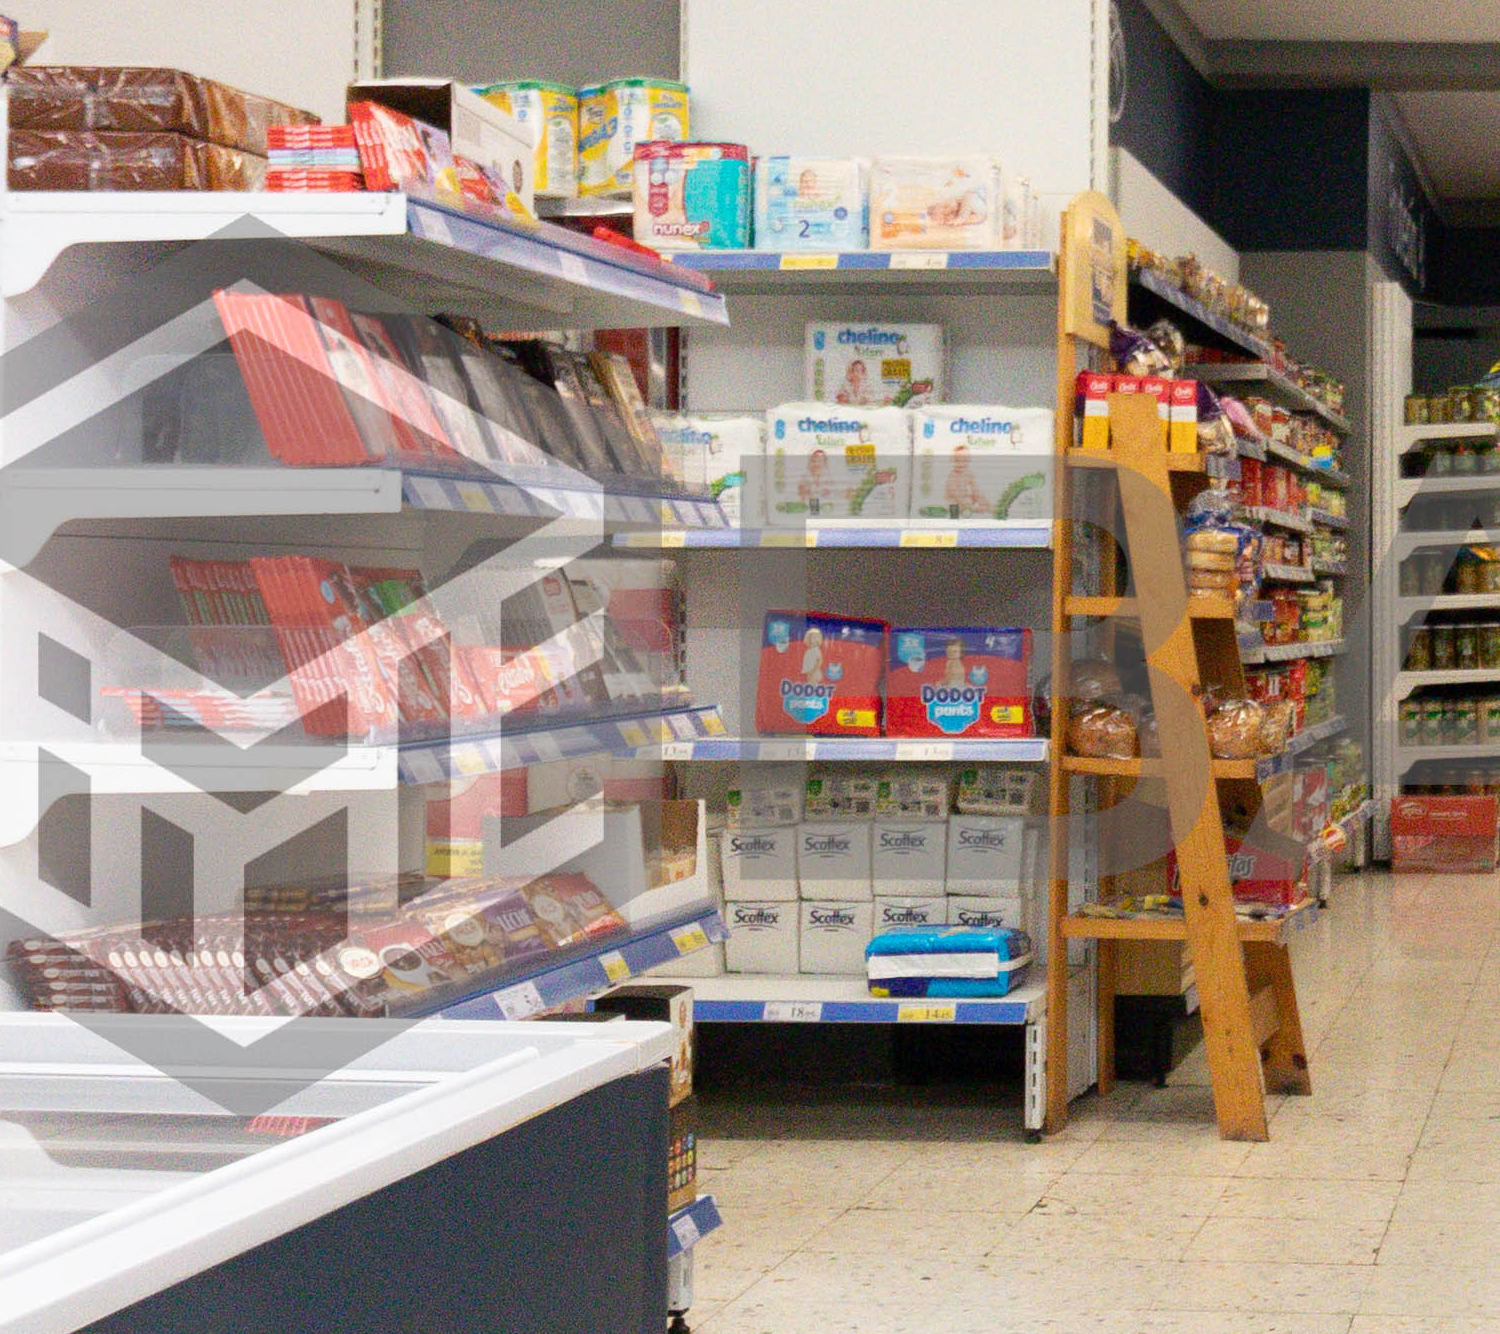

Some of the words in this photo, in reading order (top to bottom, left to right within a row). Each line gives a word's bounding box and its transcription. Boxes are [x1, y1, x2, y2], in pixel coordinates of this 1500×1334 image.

[781, 679, 835, 698] DODOT
[922, 685, 986, 704] DODOT
[731, 838, 776, 852] Scottex
[804, 837, 850, 852] Scottex
[880, 831, 926, 848] Scottex
[958, 830, 1005, 846] Scottex
[734, 909, 779, 924] Scottex
[810, 910, 855, 925] Scottex
[883, 908, 928, 923] Scottex
